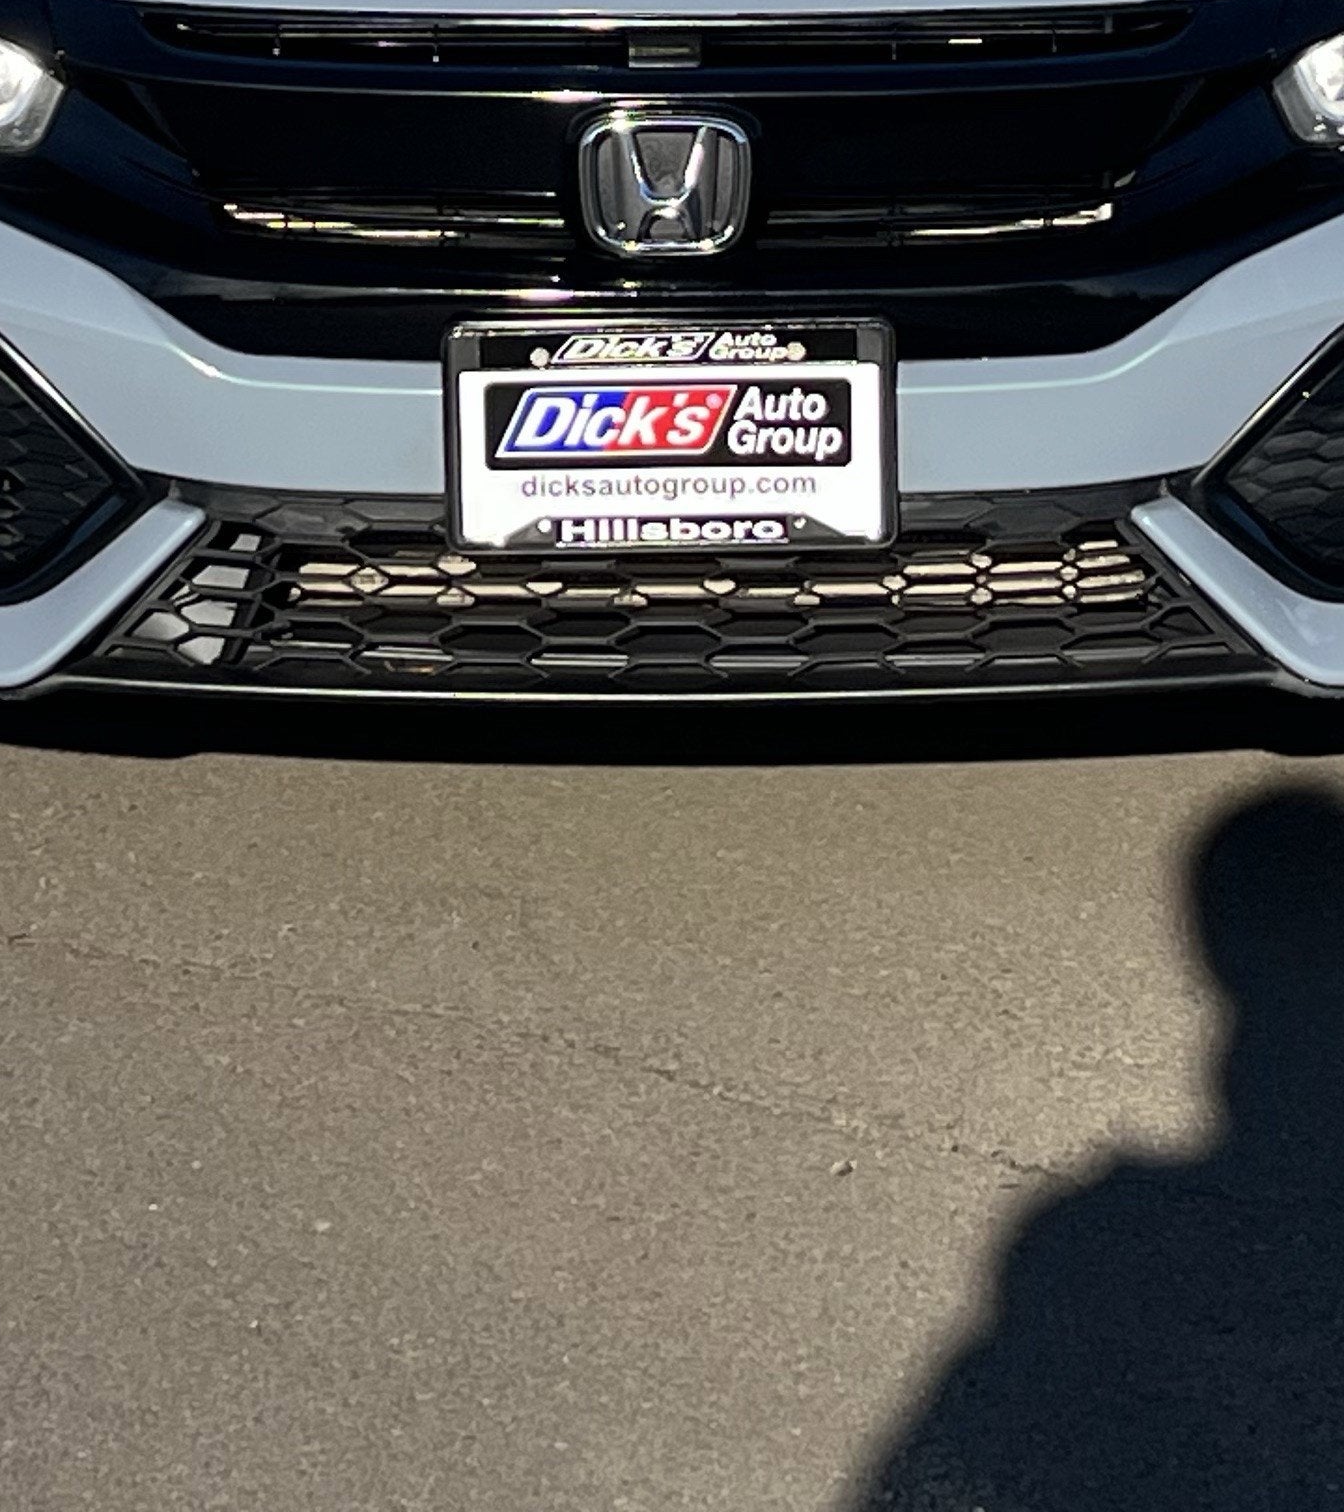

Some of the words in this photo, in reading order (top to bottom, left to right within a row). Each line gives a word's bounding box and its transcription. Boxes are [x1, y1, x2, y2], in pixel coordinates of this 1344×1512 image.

[718, 332, 778, 346] Auto
[709, 346, 788, 361] Group
[515, 395, 709, 448] Dick's
[734, 387, 826, 421] Auto
[727, 422, 843, 461] Group
[521, 474, 817, 501] dicksautogroup.com
[561, 518, 785, 543] Hillsboro
